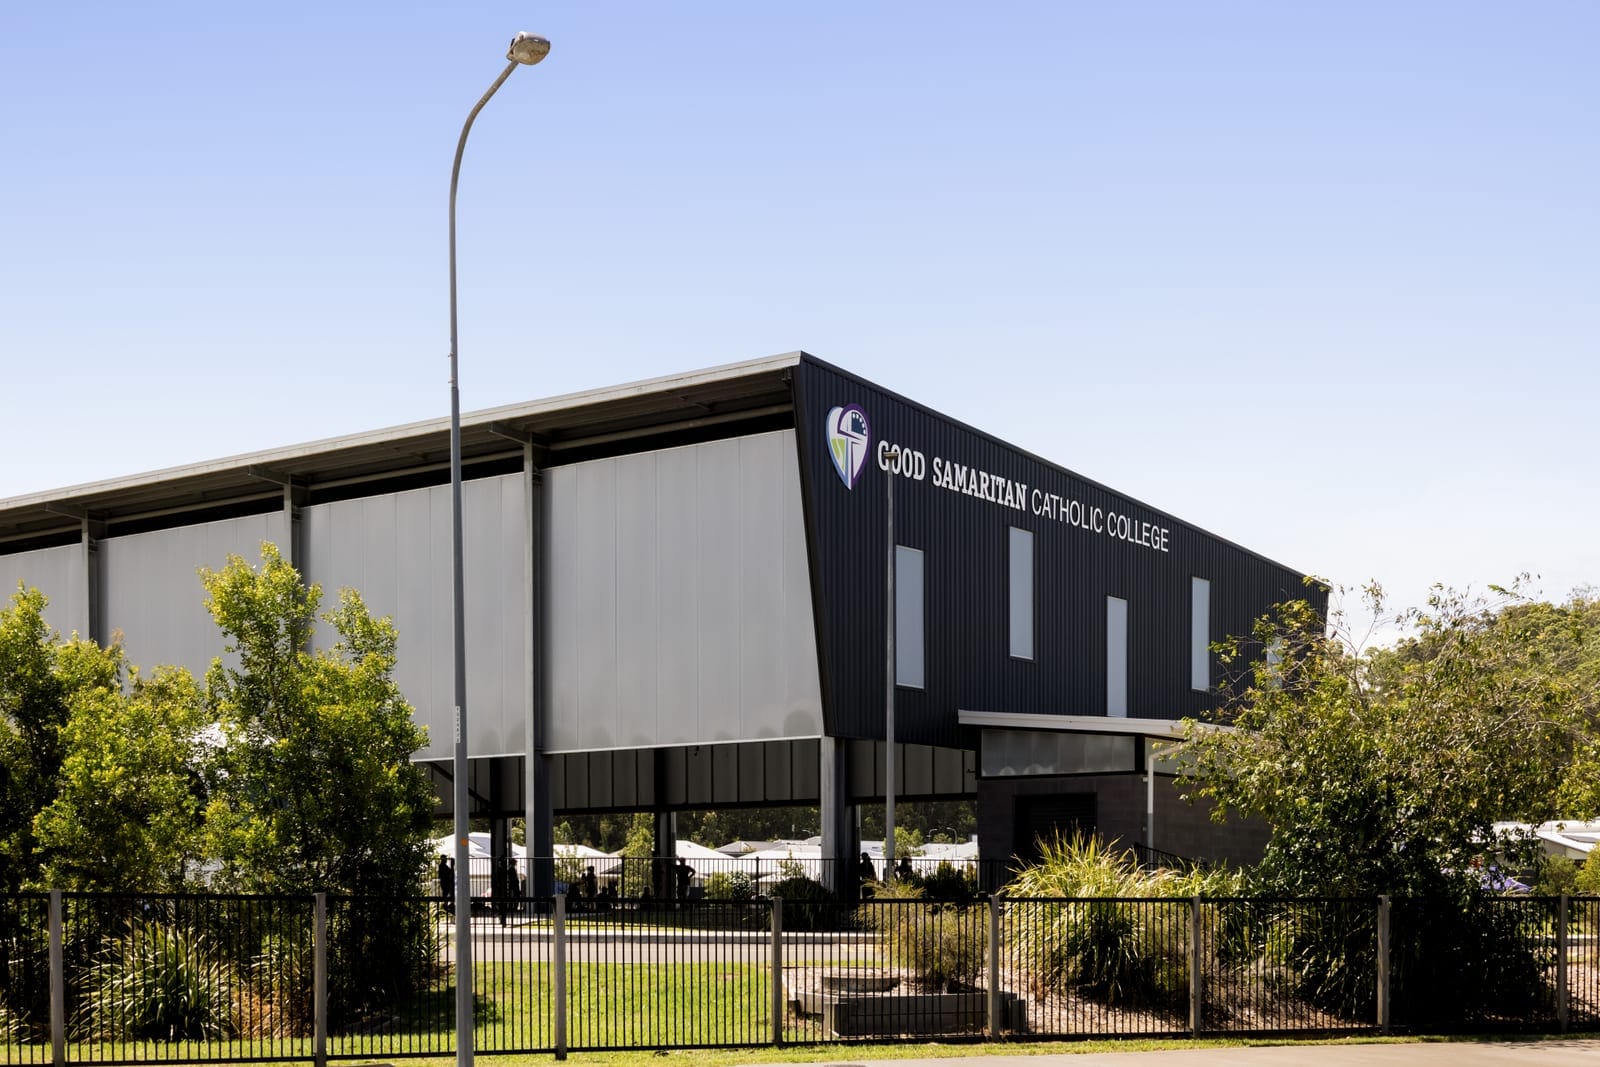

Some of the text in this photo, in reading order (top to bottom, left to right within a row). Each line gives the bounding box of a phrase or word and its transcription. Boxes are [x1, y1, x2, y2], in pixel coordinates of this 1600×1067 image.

[877, 440, 1169, 553] GOOD SAMARITAN CATHOLIC COLLEGE
